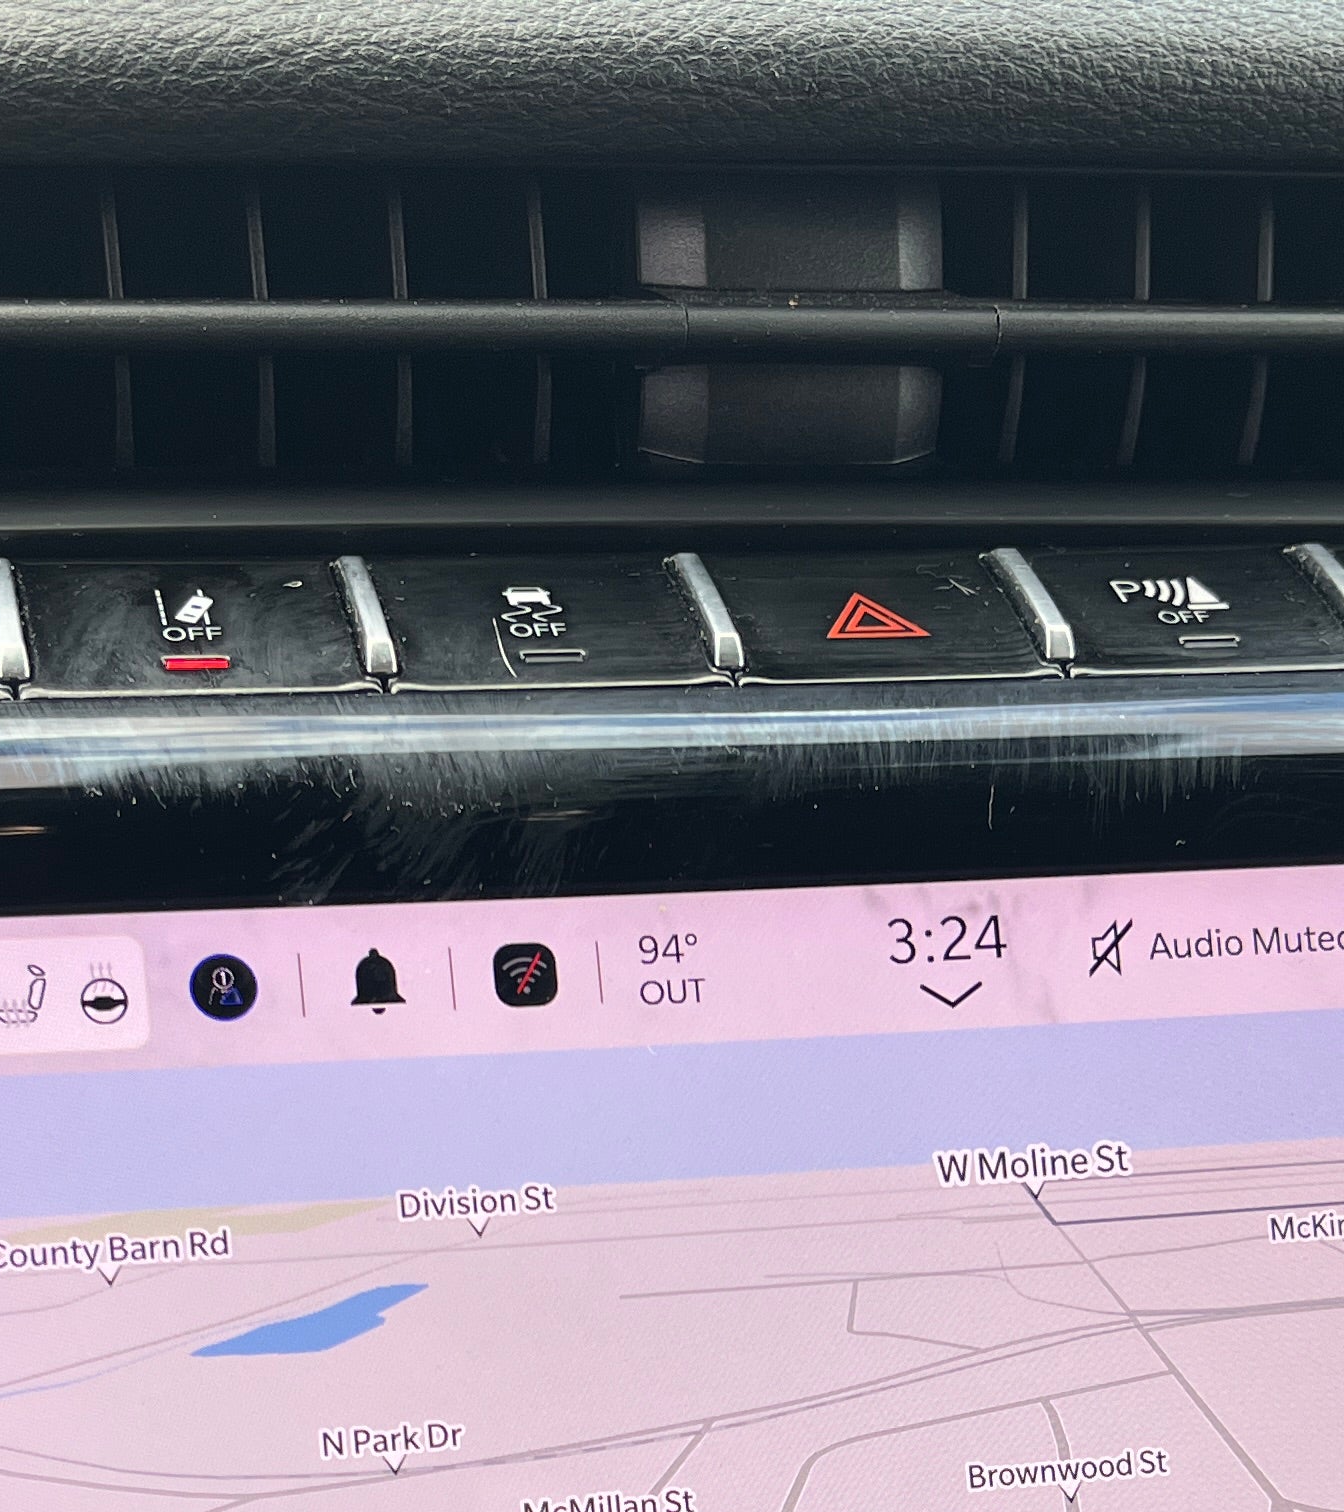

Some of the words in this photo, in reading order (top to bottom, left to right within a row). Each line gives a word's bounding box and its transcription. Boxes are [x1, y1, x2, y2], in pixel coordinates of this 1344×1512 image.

[162, 626, 223, 641] OFF
[509, 622, 567, 637] OFF
[1158, 610, 1209, 625] OFF
[638, 932, 698, 965] 94°
[887, 914, 1008, 964] 3:24
[1149, 929, 1244, 961] Audio
[639, 978, 706, 1005] OUT
[937, 1154, 969, 1182] W
[978, 1149, 1088, 1179] Moline
[1096, 1145, 1130, 1174] St
[399, 1189, 517, 1219] Division
[524, 1186, 555, 1212] St
[109, 1235, 180, 1262] Barn
[188, 1230, 230, 1257] Rd
[322, 1433, 342, 1457] N
[354, 1427, 421, 1453] Park
[427, 1425, 462, 1449] Dr
[967, 1451, 1133, 1490] Brownwood
[1140, 1450, 1168, 1476] St
